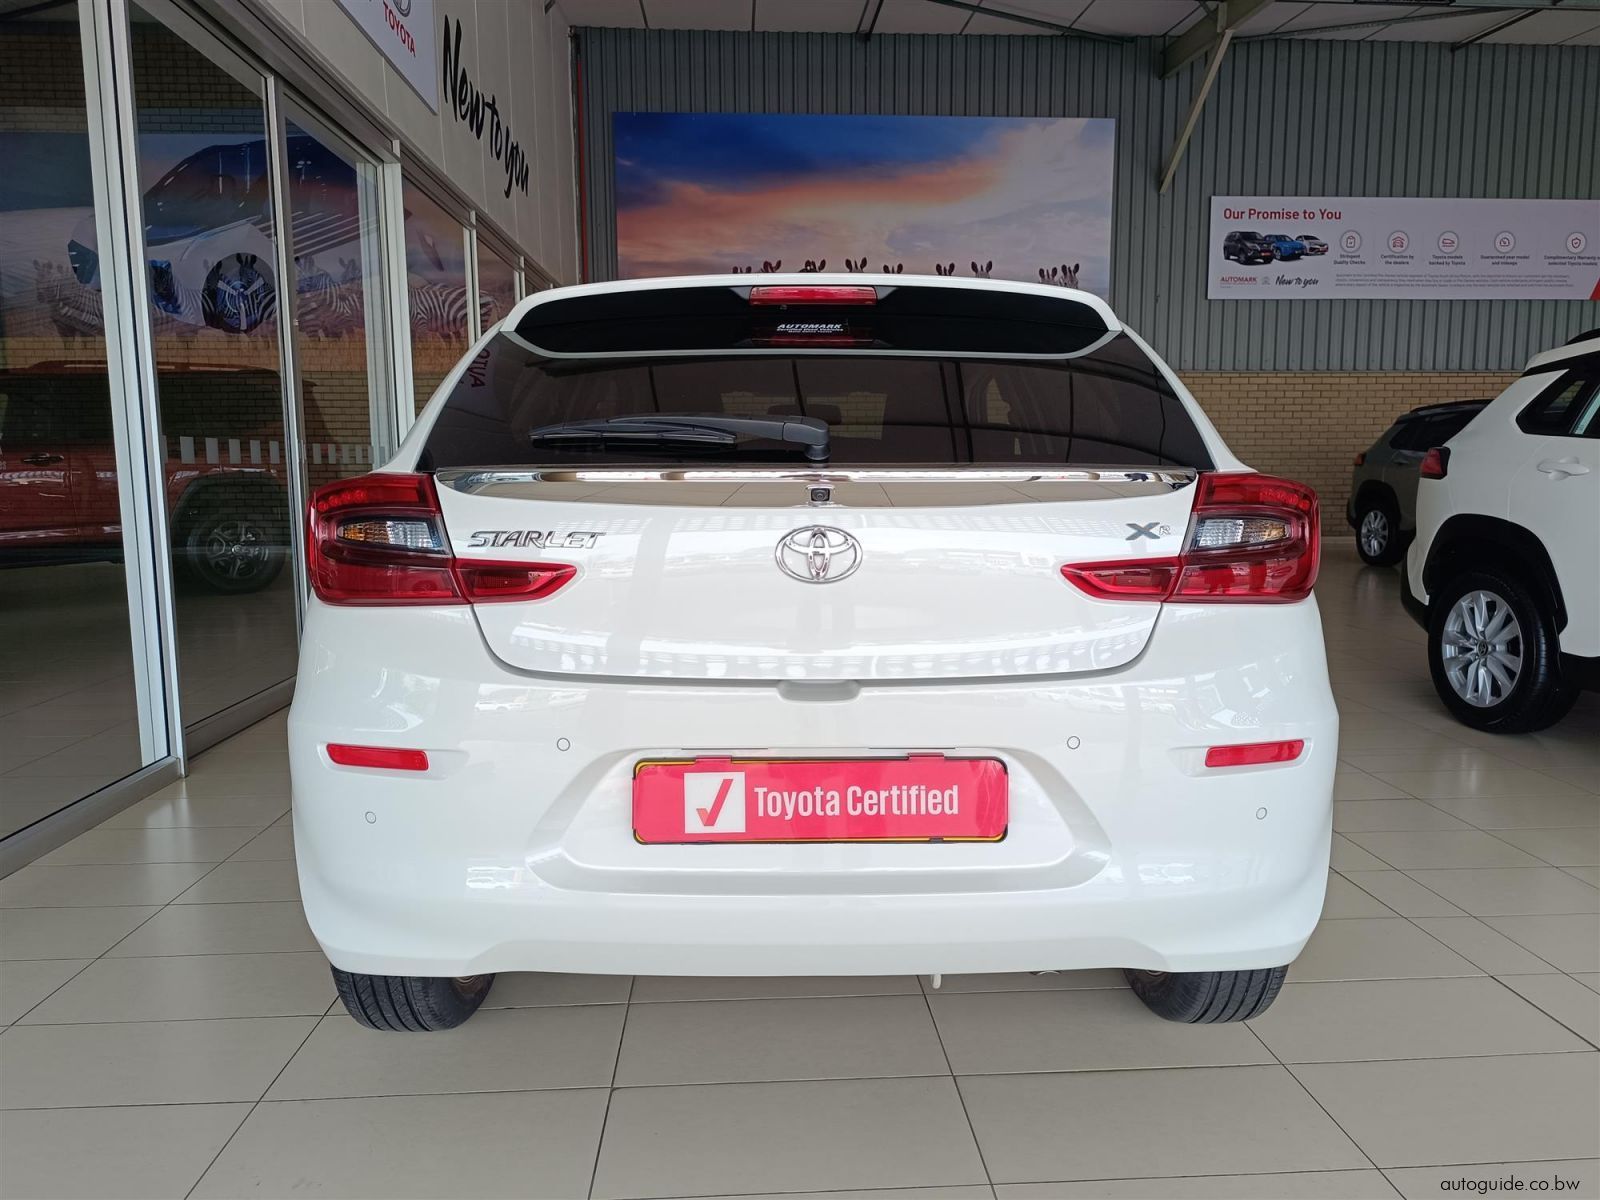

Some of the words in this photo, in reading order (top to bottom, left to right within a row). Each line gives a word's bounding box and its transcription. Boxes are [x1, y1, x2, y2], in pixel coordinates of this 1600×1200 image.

[382, 0, 416, 57] TOYOTA
[443, 14, 485, 140] New
[485, 94, 502, 161] to
[504, 126, 529, 199] you
[1223, 208, 1245, 220] Our
[1248, 208, 1300, 220] Promise
[1303, 209, 1315, 220] to
[1319, 208, 1342, 220] You
[1275, 274, 1293, 286] New
[1302, 278, 1319, 288] you
[467, 530, 607, 549] STARLET
[753, 786, 841, 821] Toyota
[847, 785, 959, 816] Certified
